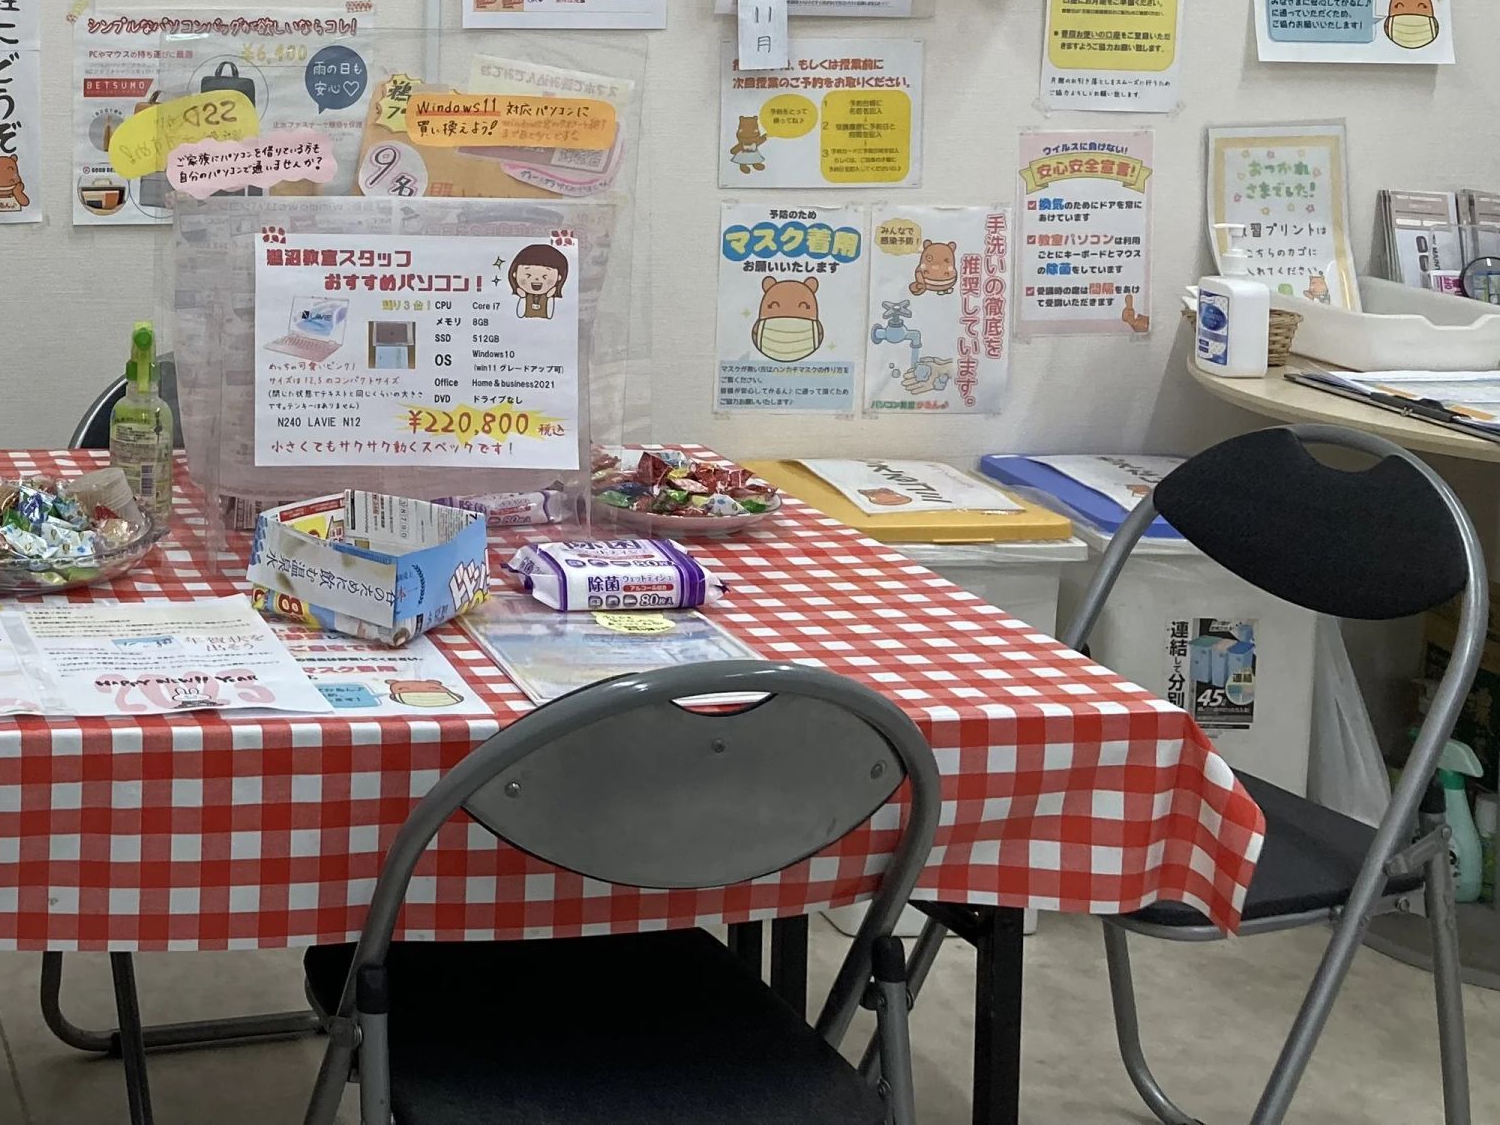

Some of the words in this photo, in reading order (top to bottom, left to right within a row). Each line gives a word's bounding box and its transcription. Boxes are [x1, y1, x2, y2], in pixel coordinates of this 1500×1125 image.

[313, 63, 362, 75] 雨の日も
[87, 81, 146, 90] BETSUMO
[416, 98, 497, 114] Windows11
[417, 120, 499, 137] 買い換えよう!
[1043, 142, 1128, 155] ウイルスに負けない!
[1039, 213, 1090, 222] あけています
[880, 226, 914, 235] みんなで
[726, 226, 858, 258] マスク着用
[1038, 250, 1141, 258] ごとにキーボードとマウス
[743, 261, 840, 274] お願いいたします
[324, 274, 482, 292] おすすめパソコン!
[985, 214, 1006, 357] 手洗いの徹底を
[435, 301, 451, 310] CPU
[435, 317, 461, 326] メモリ
[435, 334, 451, 343] SSD
[473, 334, 500, 343] 512GB
[435, 354, 452, 366] OS
[473, 350, 514, 359] Windows10
[434, 395, 451, 403] DVD
[473, 395, 522, 404] ドライブなし
[278, 417, 301, 427] N240
[308, 417, 335, 427] LAVIE
[408, 409, 529, 435] ¥220,800
[588, 577, 619, 592] 除菌
